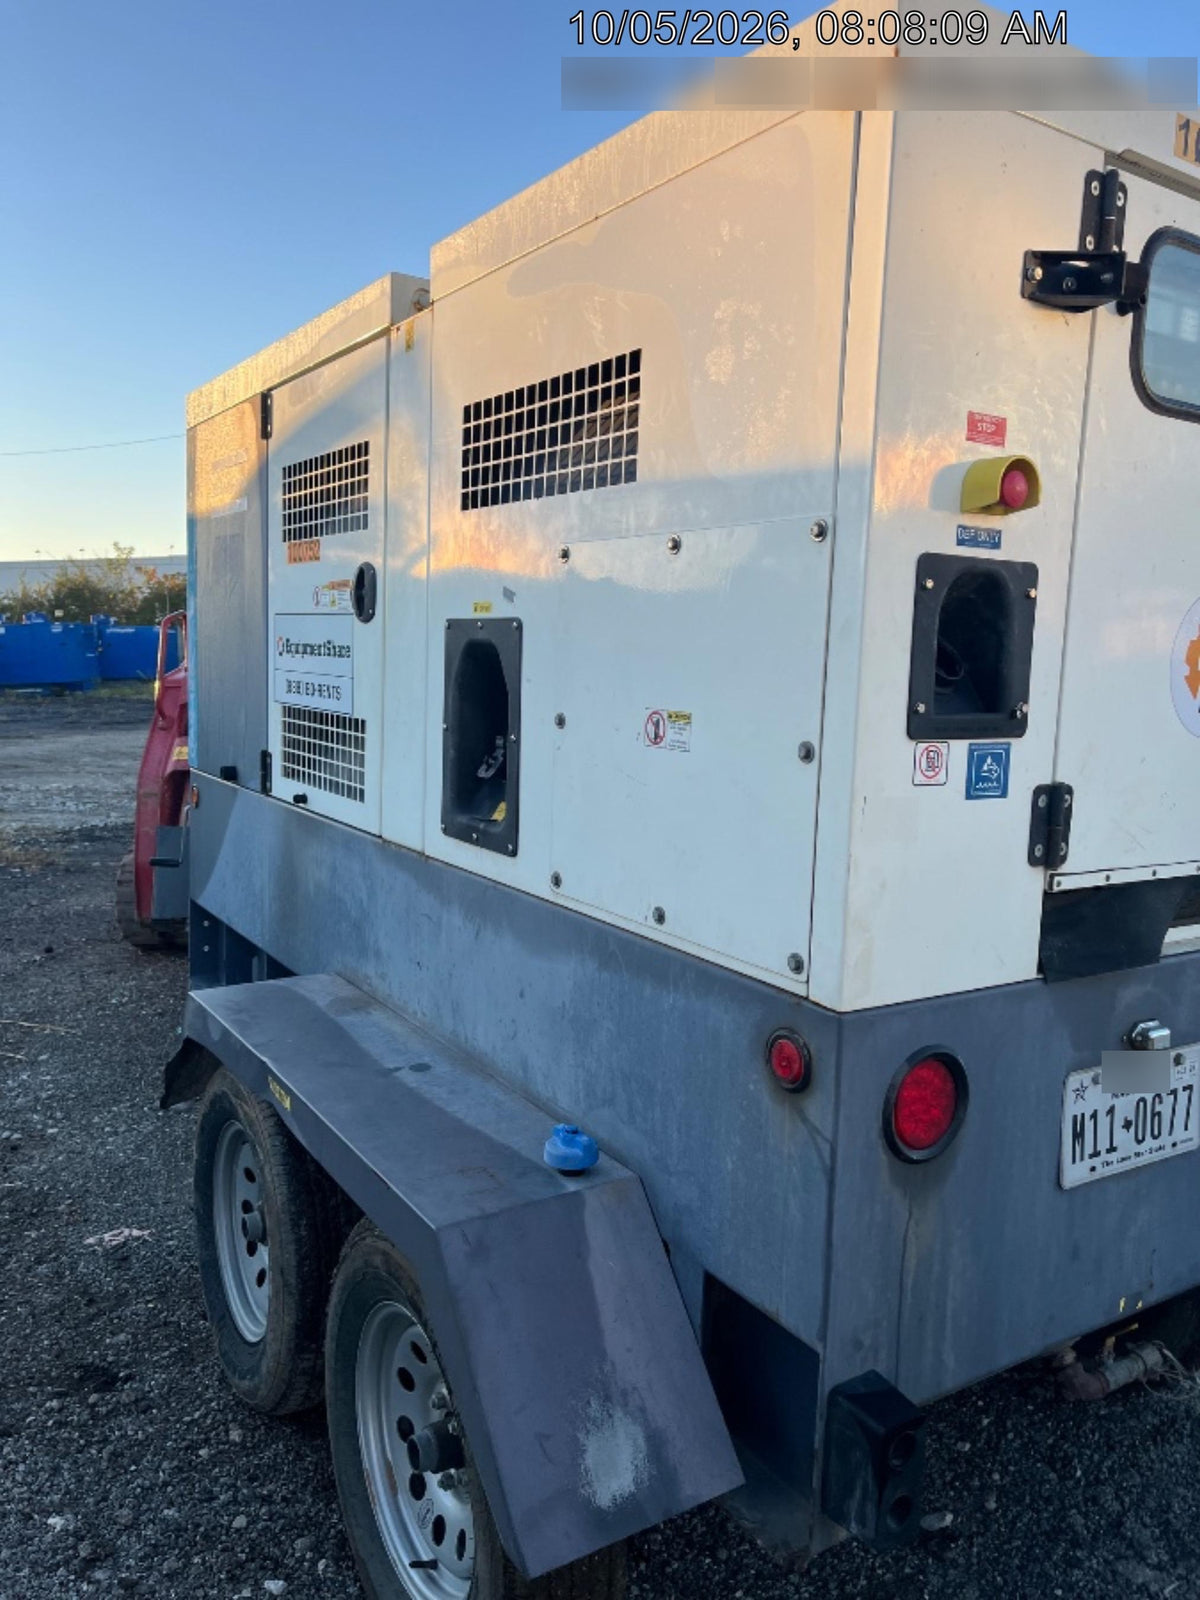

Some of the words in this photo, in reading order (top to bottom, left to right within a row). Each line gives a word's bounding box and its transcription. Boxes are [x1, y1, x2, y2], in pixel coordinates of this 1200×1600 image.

[976, 422, 997, 433] STOP
[957, 527, 976, 540] DEF
[977, 530, 1000, 543] ONLY
[1072, 1104, 1118, 1165] M11
[1134, 1083, 1194, 1146] 0677
